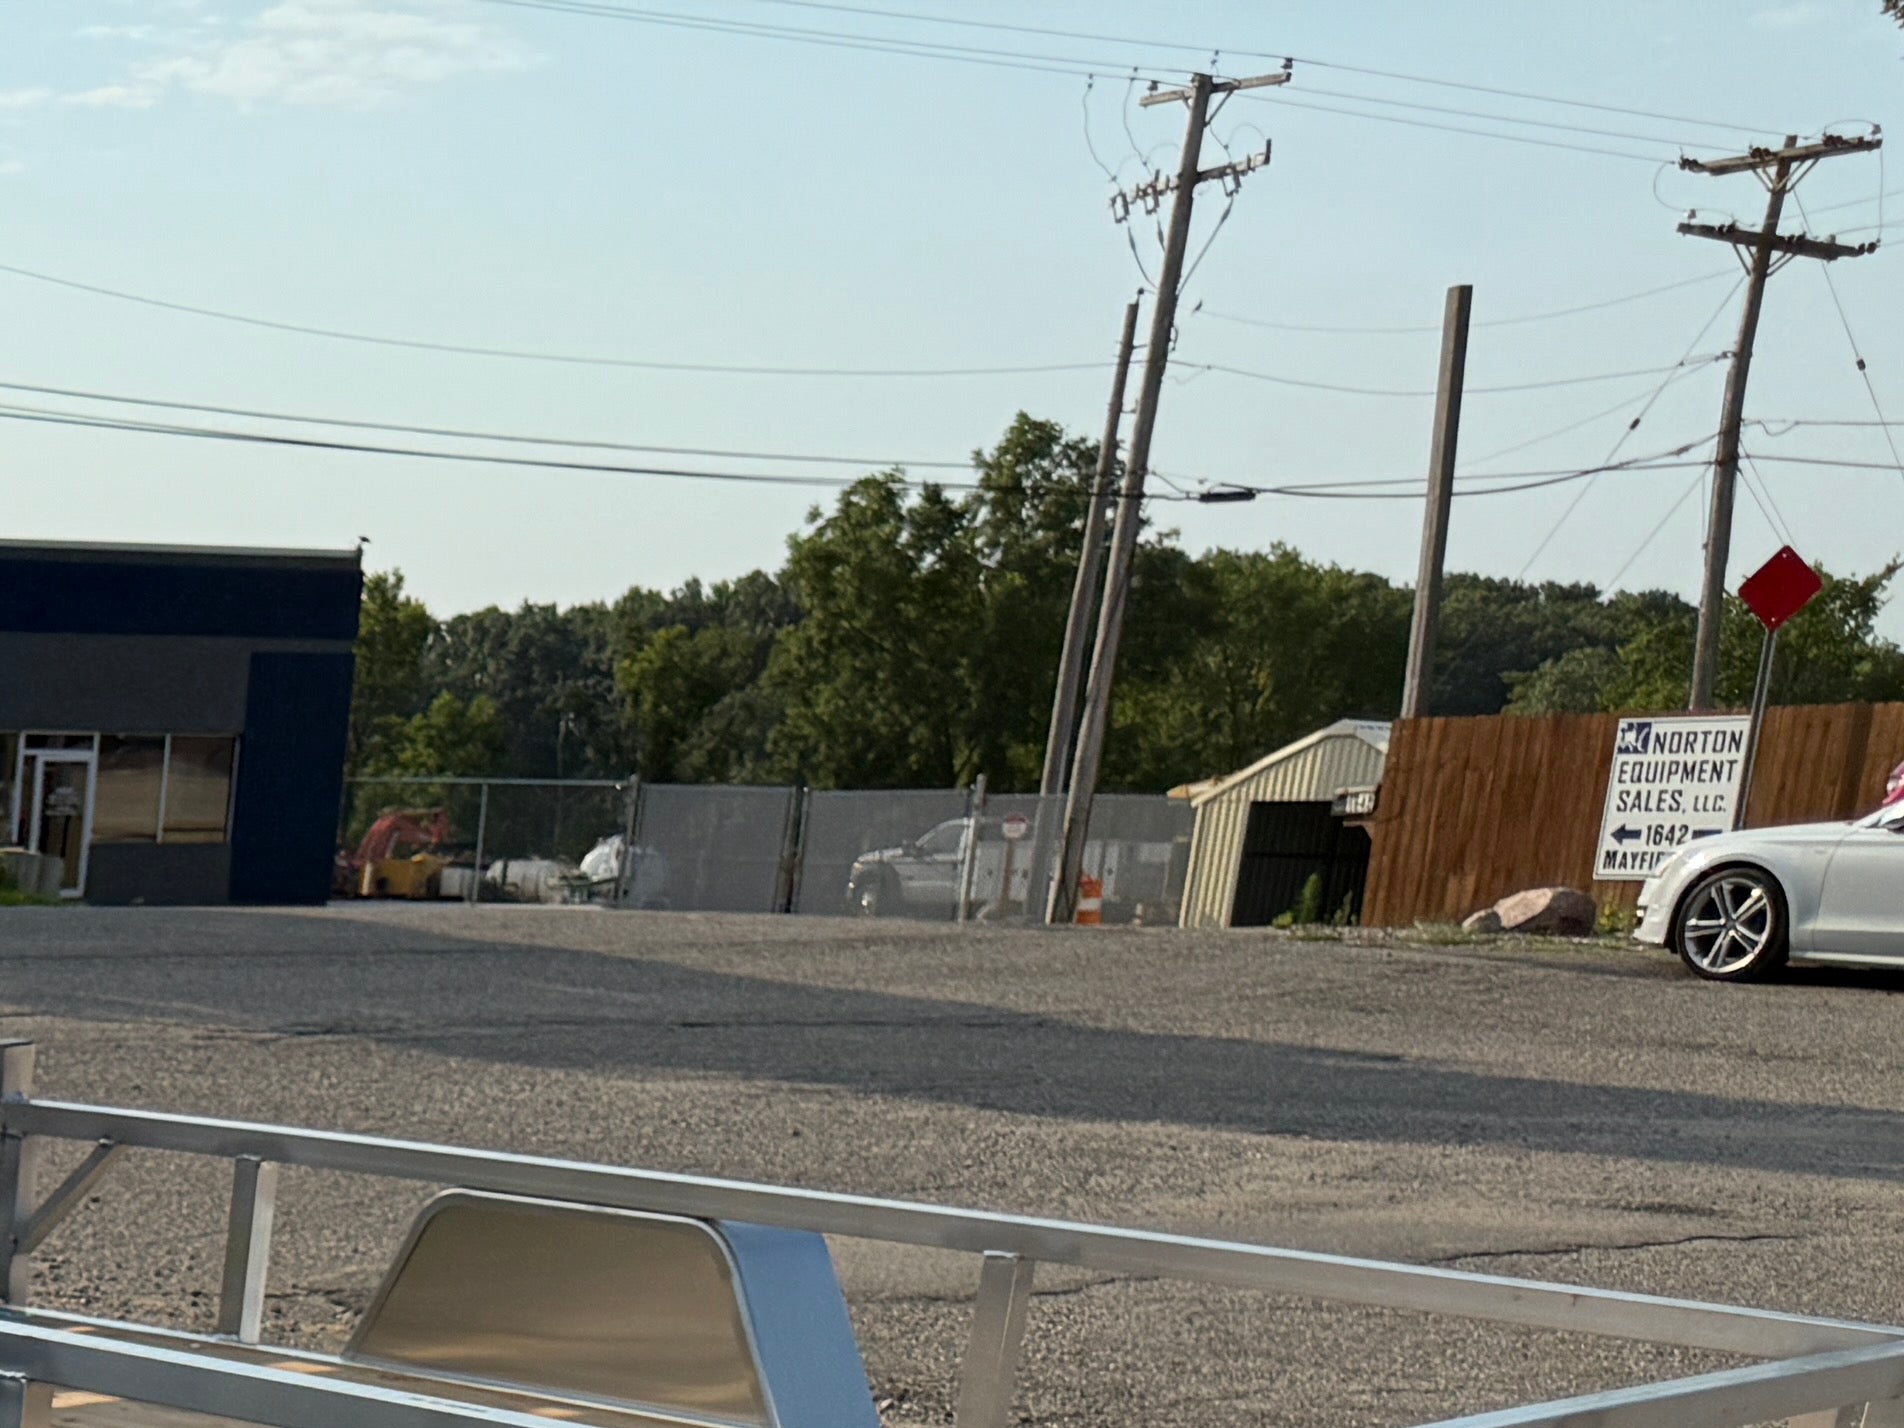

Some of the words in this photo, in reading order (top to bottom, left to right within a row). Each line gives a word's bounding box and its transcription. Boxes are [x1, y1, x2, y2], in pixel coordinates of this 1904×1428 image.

[1652, 730, 1743, 755] NORTON
[1617, 759, 1738, 784] EQUIPMENT
[1616, 790, 1686, 814] SALES,
[1645, 824, 1689, 846] 1642
